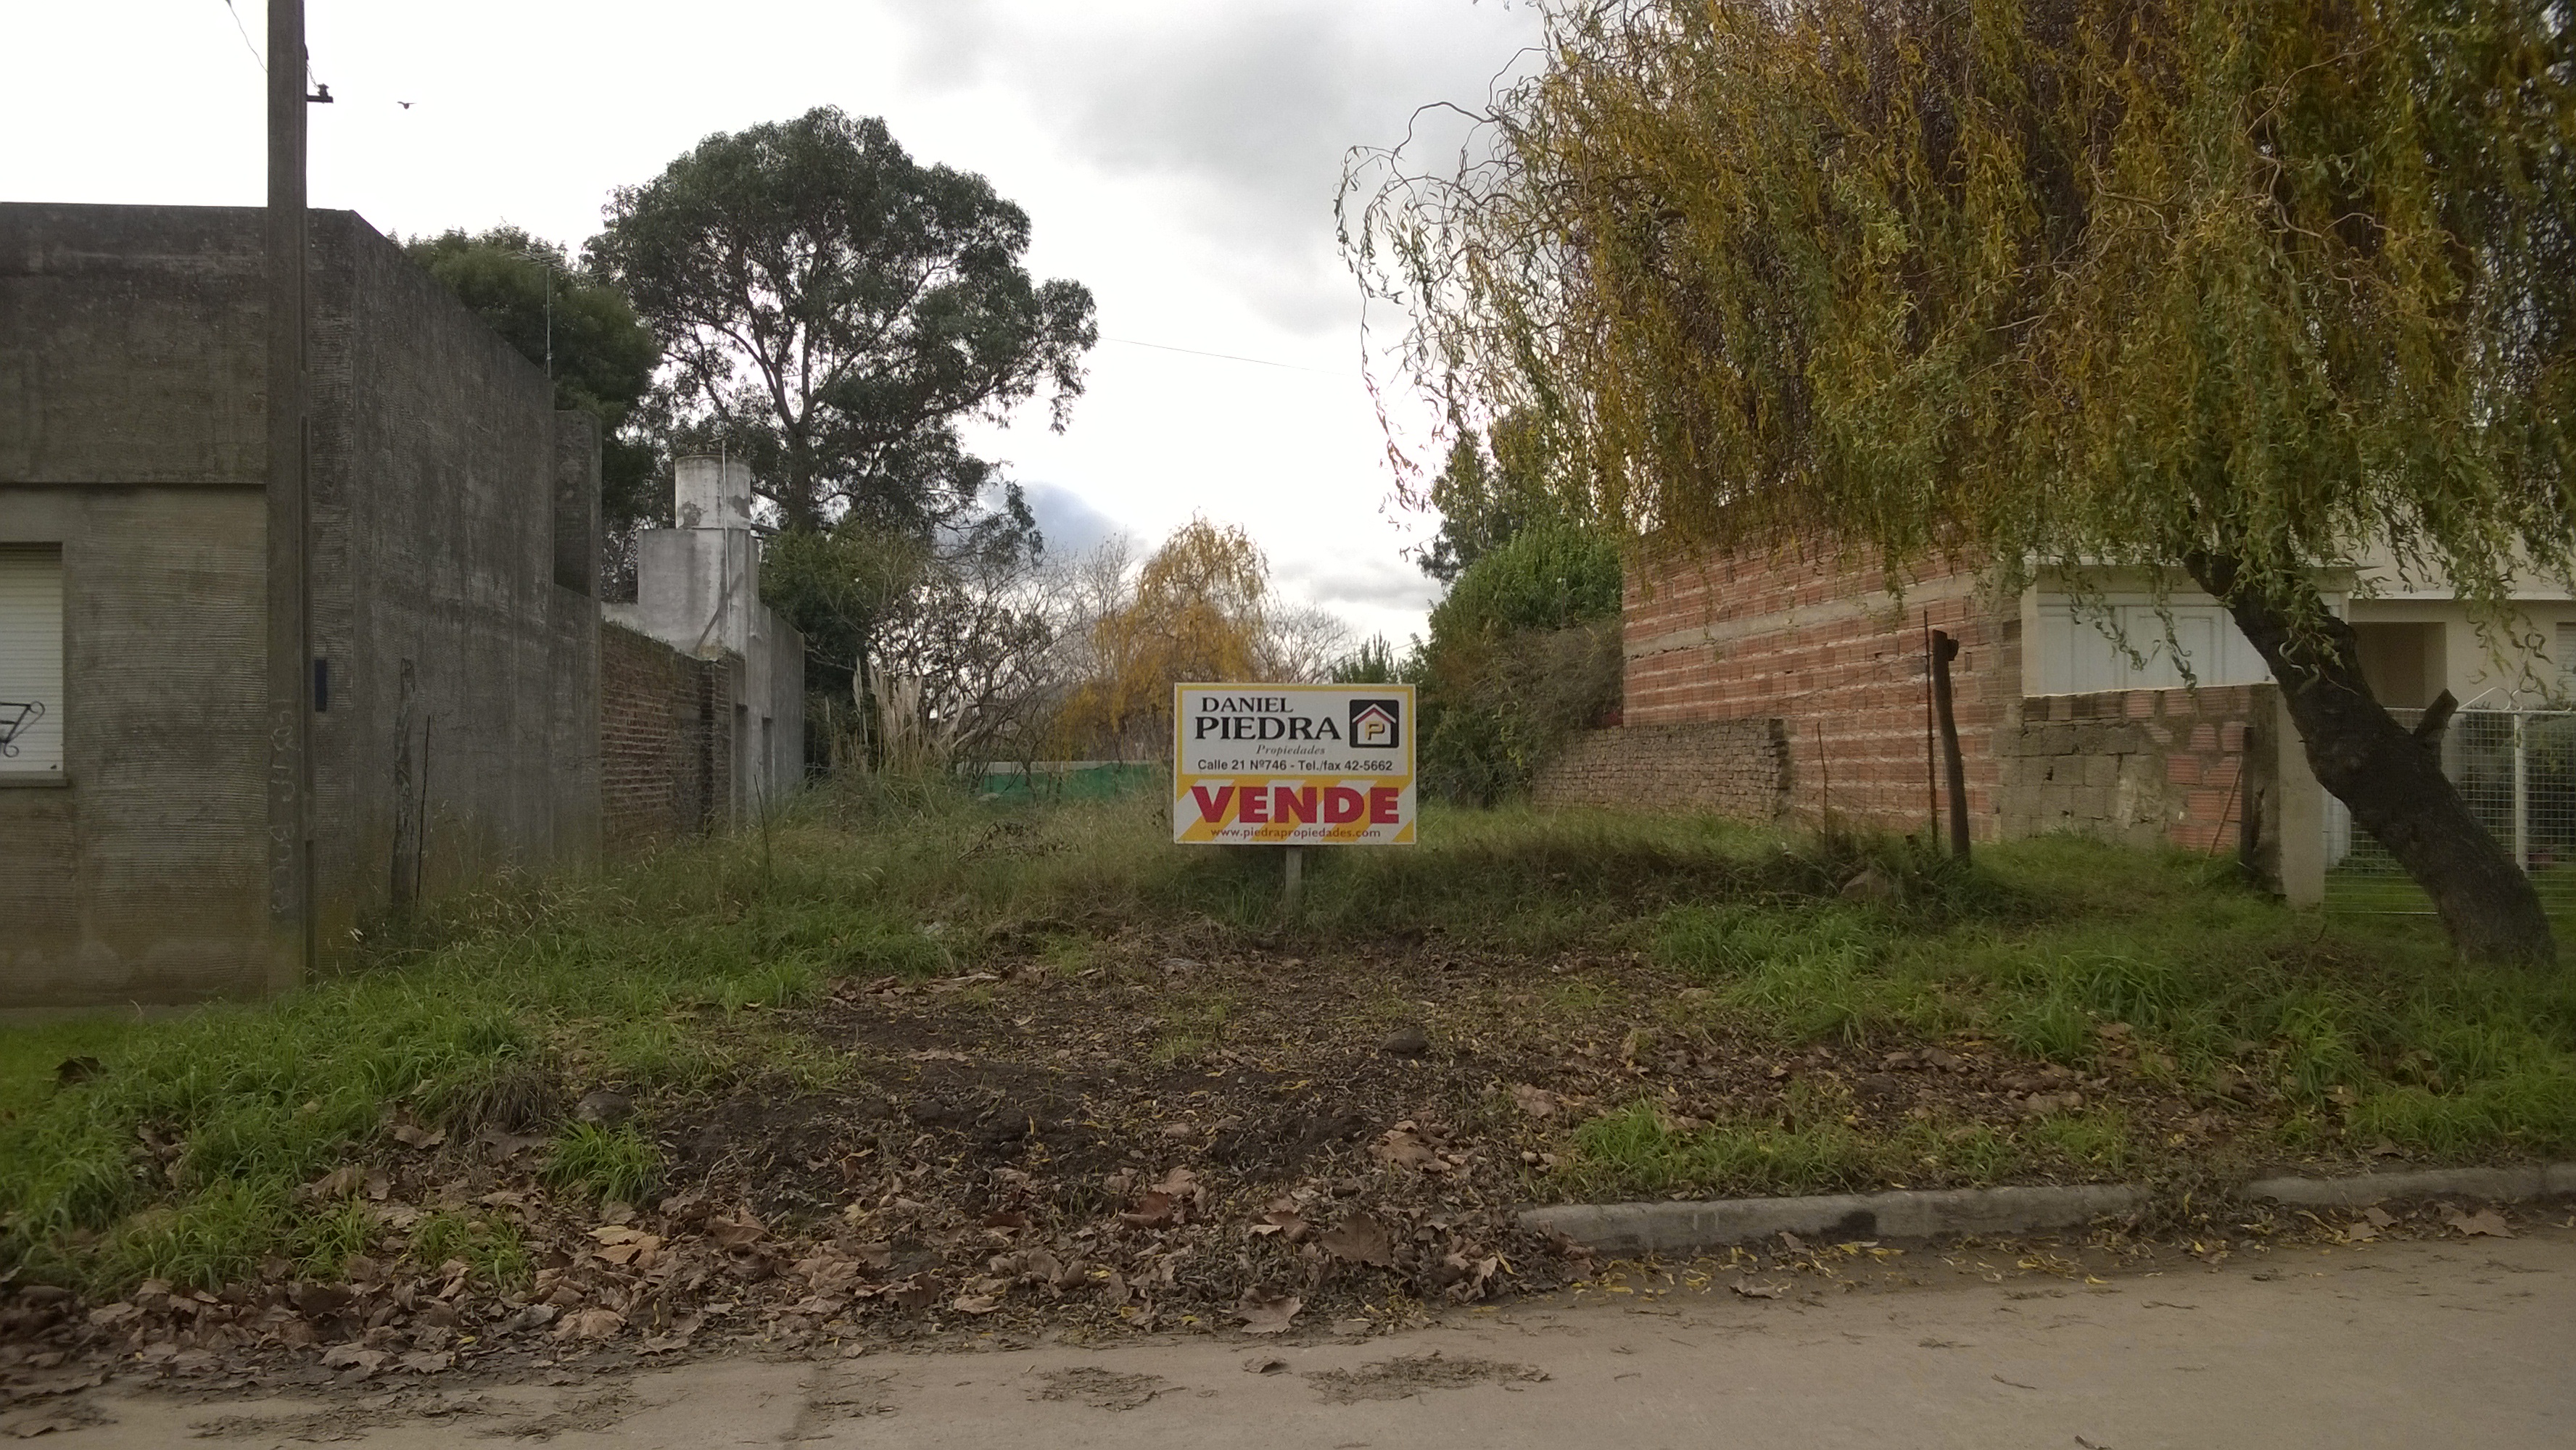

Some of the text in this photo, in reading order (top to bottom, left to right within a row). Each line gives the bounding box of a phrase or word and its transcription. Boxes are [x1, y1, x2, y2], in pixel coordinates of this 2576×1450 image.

[1201, 697, 1294, 713] DANIEL
[1194, 716, 1342, 740] PIEDRA
[1256, 744, 1326, 756] Propiedades
[1197, 759, 1229, 771] Calle
[1231, 760, 1245, 771] 21
[1344, 760, 1393, 771] 42-5662
[1191, 786, 1400, 824] VENDE
[1210, 827, 1381, 839] www.piedrapropiedades.com
